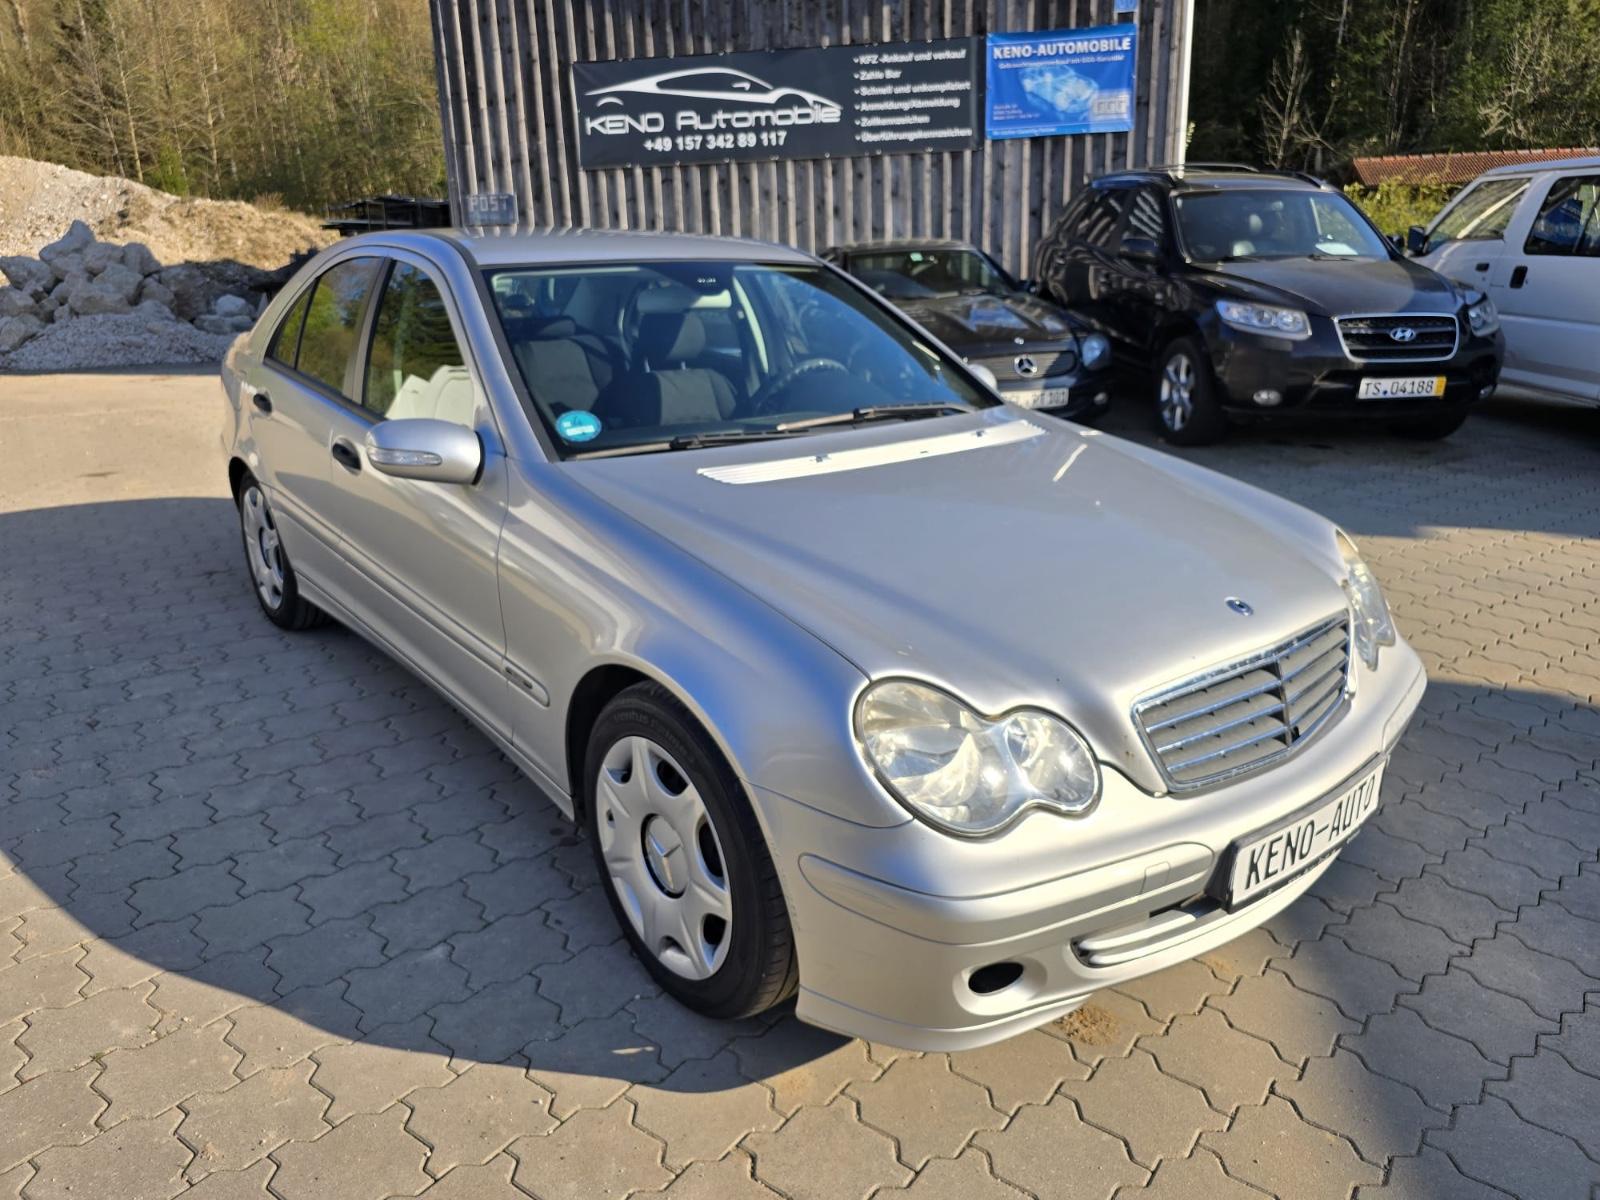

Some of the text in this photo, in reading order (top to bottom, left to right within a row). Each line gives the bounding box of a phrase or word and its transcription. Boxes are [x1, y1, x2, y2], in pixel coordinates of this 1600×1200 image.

[914, 51, 932, 61] und
[993, 37, 1131, 59] KENO-AUTOMOBILE
[893, 84, 911, 94] und
[585, 106, 841, 135] KENO Automobile
[644, 130, 787, 151] +49 157 342 89 117
[468, 195, 509, 212] POST
[1364, 380, 1434, 395] TS 04188
[1245, 774, 1376, 889] KENO-AUTO
